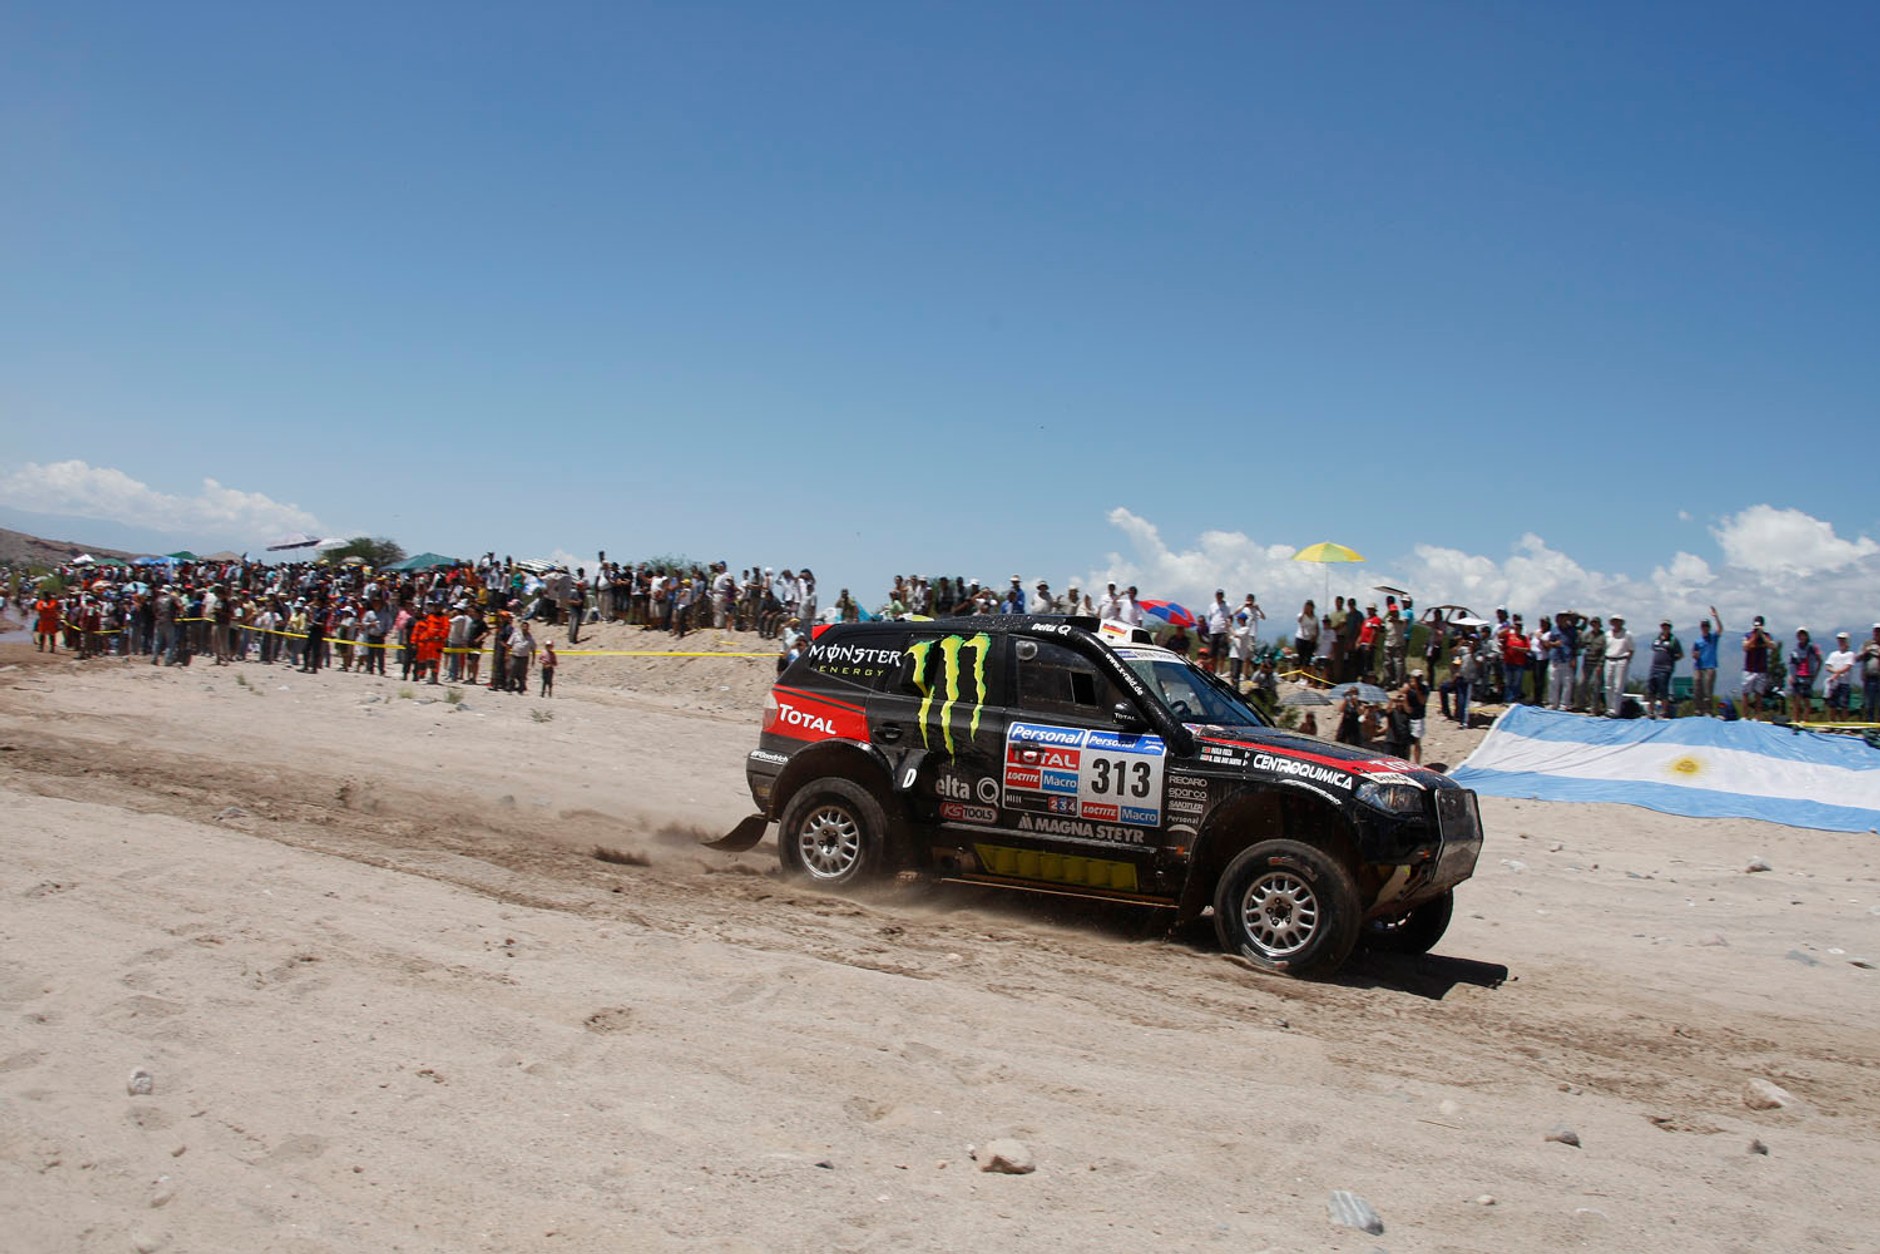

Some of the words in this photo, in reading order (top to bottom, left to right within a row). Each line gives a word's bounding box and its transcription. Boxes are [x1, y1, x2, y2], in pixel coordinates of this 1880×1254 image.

[1057, 624, 1072, 636] Q
[818, 664, 884, 677] ENERGY
[1105, 652, 1144, 696] www.x-raid.de
[779, 703, 837, 735] TOTAL
[1113, 712, 1137, 721] TOTAL
[1011, 725, 1083, 745] Personal
[1088, 735, 1137, 749] Personal
[1006, 771, 1040, 783] LOCTITE
[1091, 757, 1151, 798] 313
[1253, 753, 1353, 790] CENTROQUIMICA
[902, 767, 918, 789] D
[935, 775, 970, 800] elta
[1043, 774, 1077, 789] Macro
[1168, 775, 1208, 788] RECARO
[1167, 786, 1207, 801] sparco
[943, 803, 963, 817] KS
[962, 806, 993, 820] TOOLS
[1083, 804, 1117, 818] LOCTITE
[1121, 808, 1157, 823] Macro
[1166, 814, 1200, 825] Personal
[1034, 817, 1094, 838] MAGNA
[1096, 824, 1145, 843] STEYR
